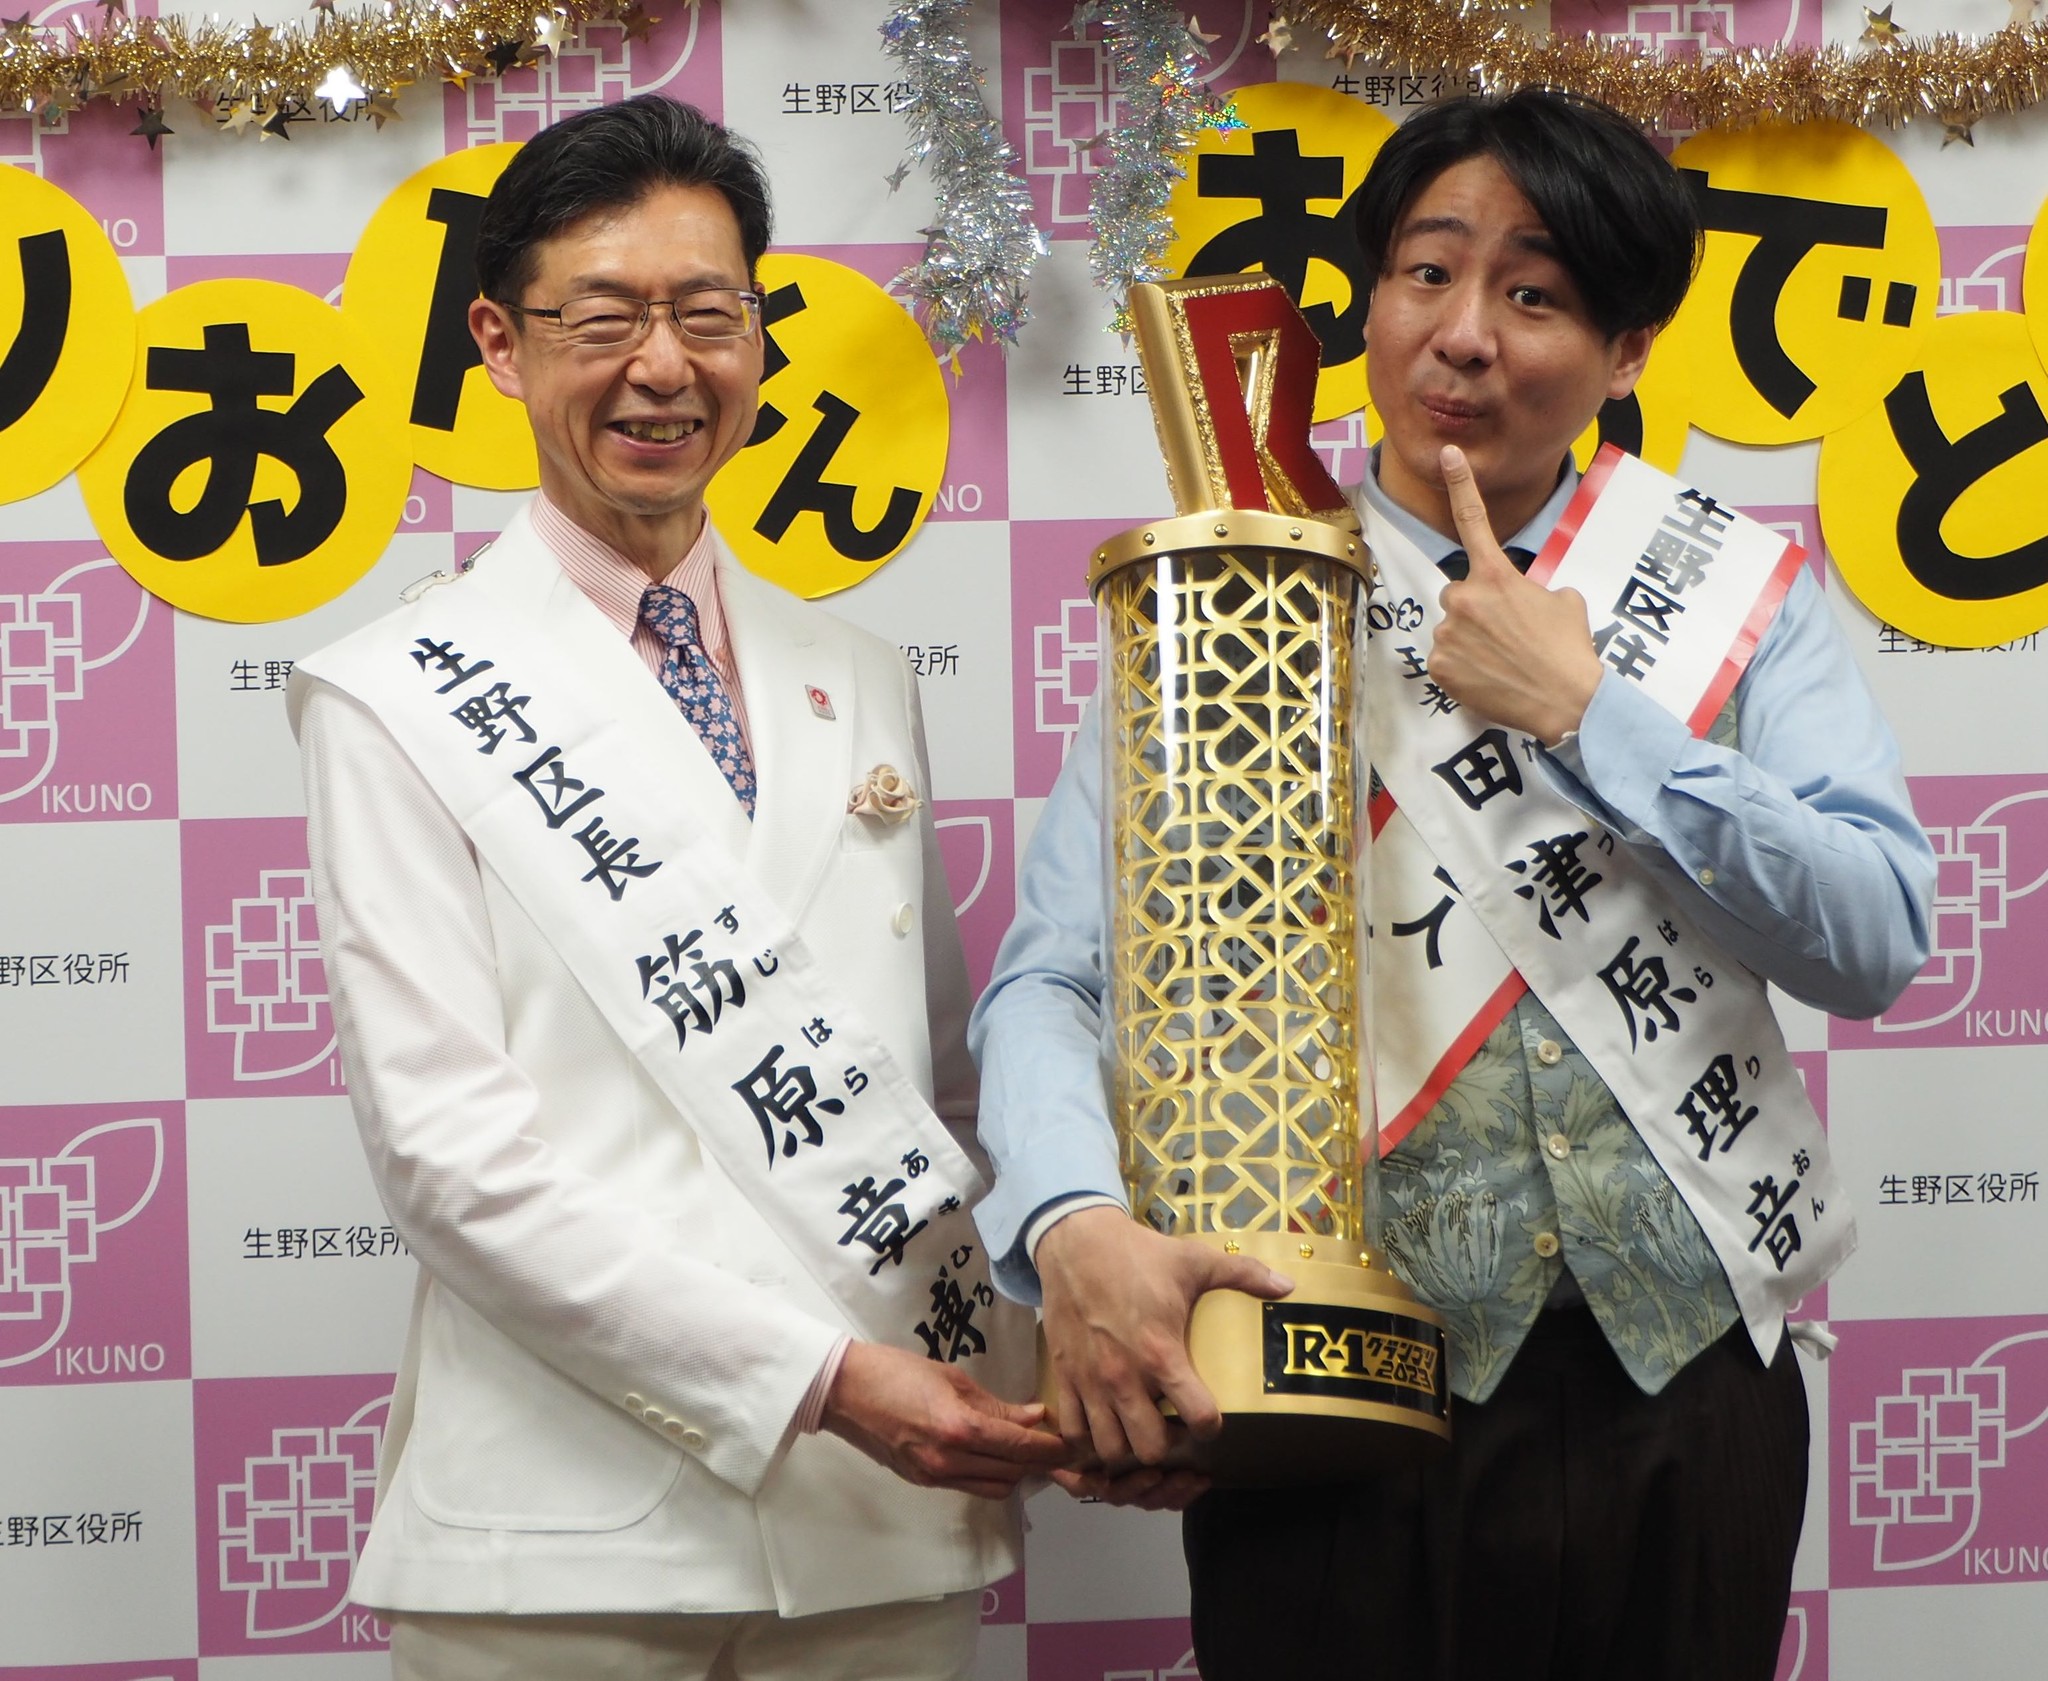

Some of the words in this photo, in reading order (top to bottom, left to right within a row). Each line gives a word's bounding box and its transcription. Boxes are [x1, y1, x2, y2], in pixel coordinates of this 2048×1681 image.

[41, 782, 152, 813] IKUNO
[1965, 1008, 2048, 1038] IKUN
[1879, 1171, 2039, 1205] 生野区役所
[55, 1343, 165, 1376] IKUNO
[0, 1511, 142, 1547] 野区役所
[1964, 1546, 2048, 1576] IKUN
